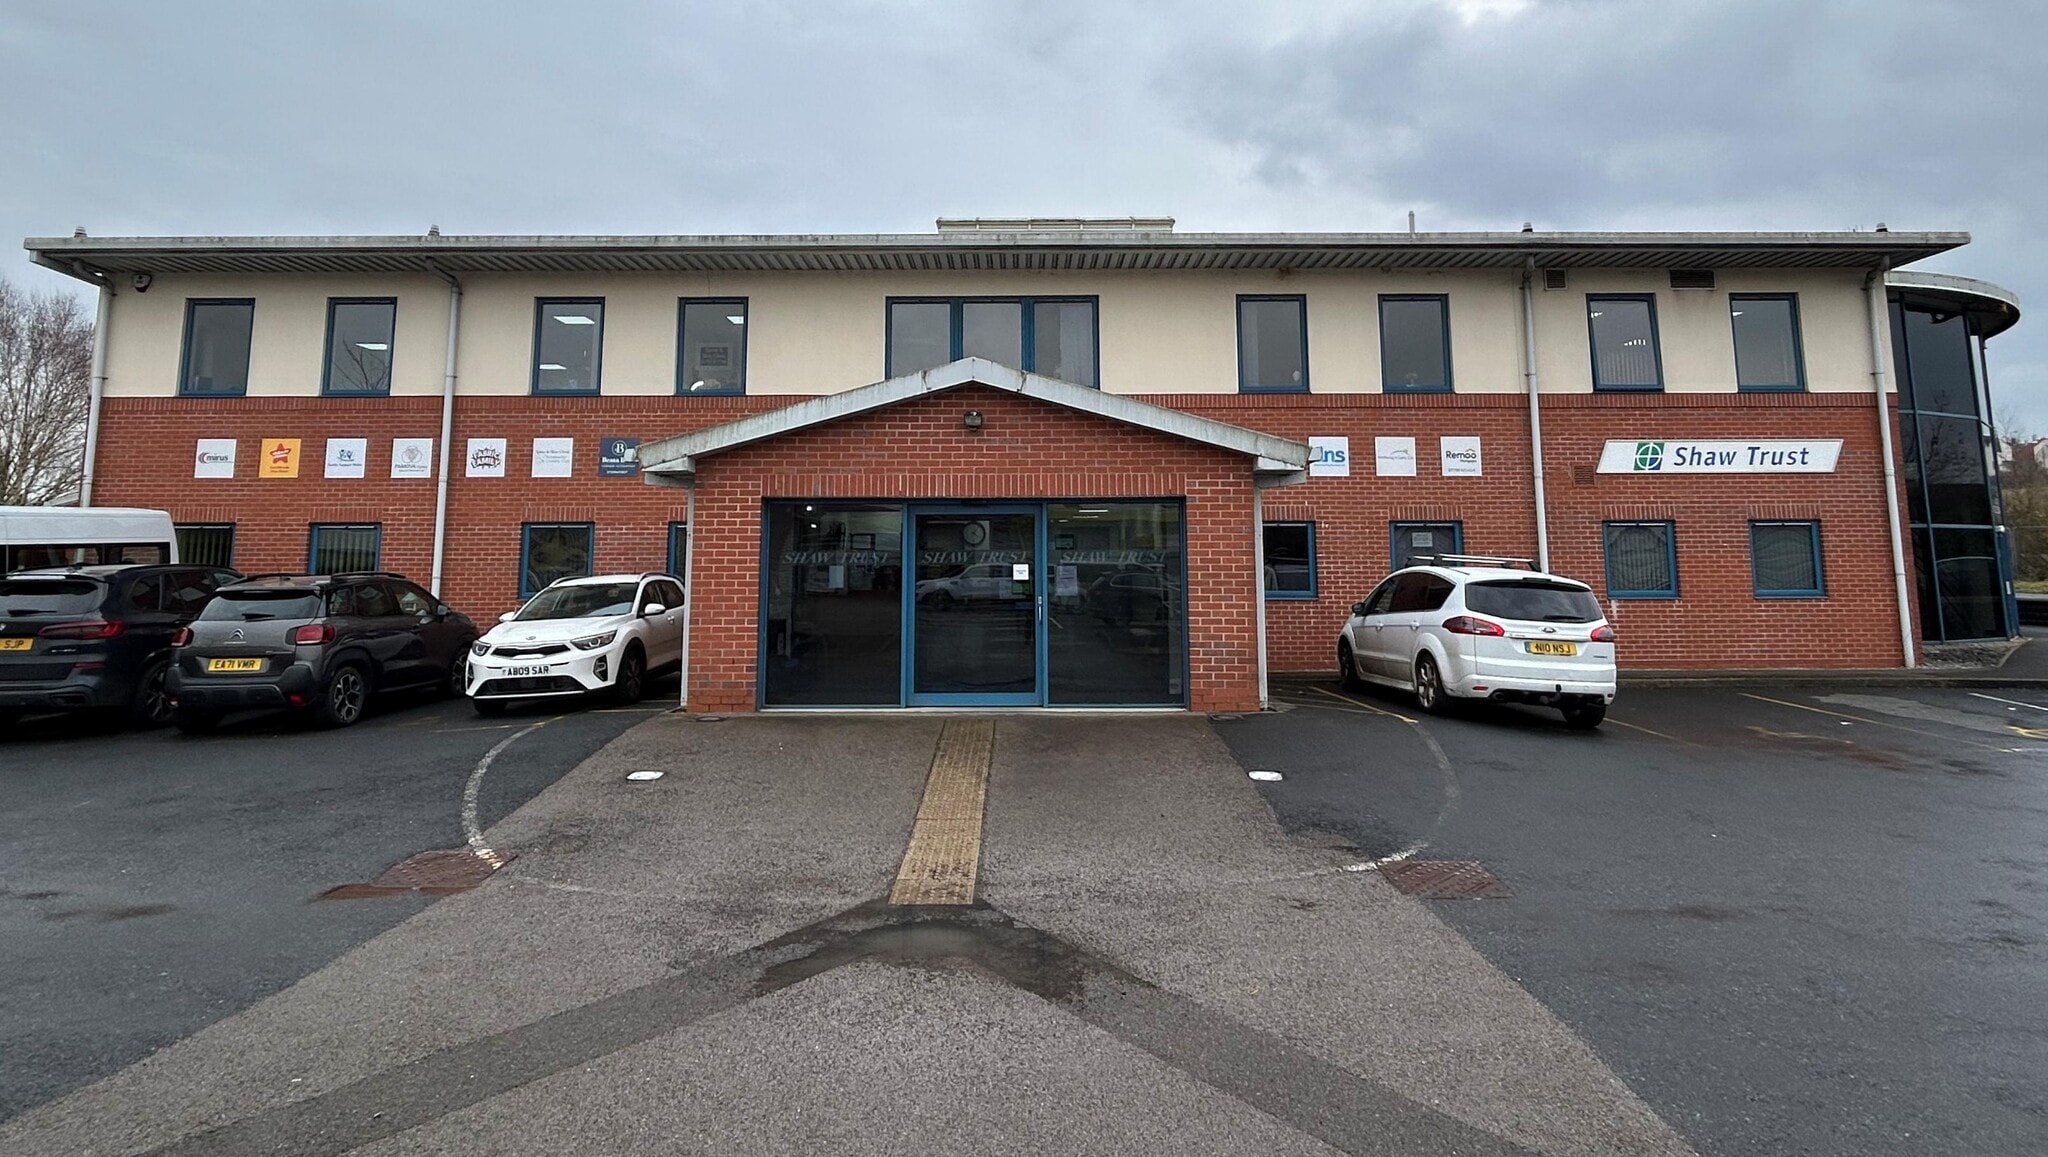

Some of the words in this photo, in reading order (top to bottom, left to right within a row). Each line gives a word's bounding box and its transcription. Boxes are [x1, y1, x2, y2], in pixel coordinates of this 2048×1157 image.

[205, 452, 229, 461] mirus
[1673, 446, 1737, 466] Shaw
[1747, 446, 1810, 466] Trust
[782, 552, 833, 564] SHAW
[840, 552, 889, 564] TRUST
[921, 551, 974, 564] SHAW
[978, 551, 1028, 563] TRUST
[1061, 551, 1108, 563] SHAW
[1118, 551, 1167, 563] TRUST
[4, 640, 25, 649] SJP
[1553, 644, 1571, 654] NSJ
[214, 660, 235, 669] EA71
[237, 660, 256, 669] VMR
[507, 666, 530, 676] AB09
[532, 665, 549, 675] SAR
